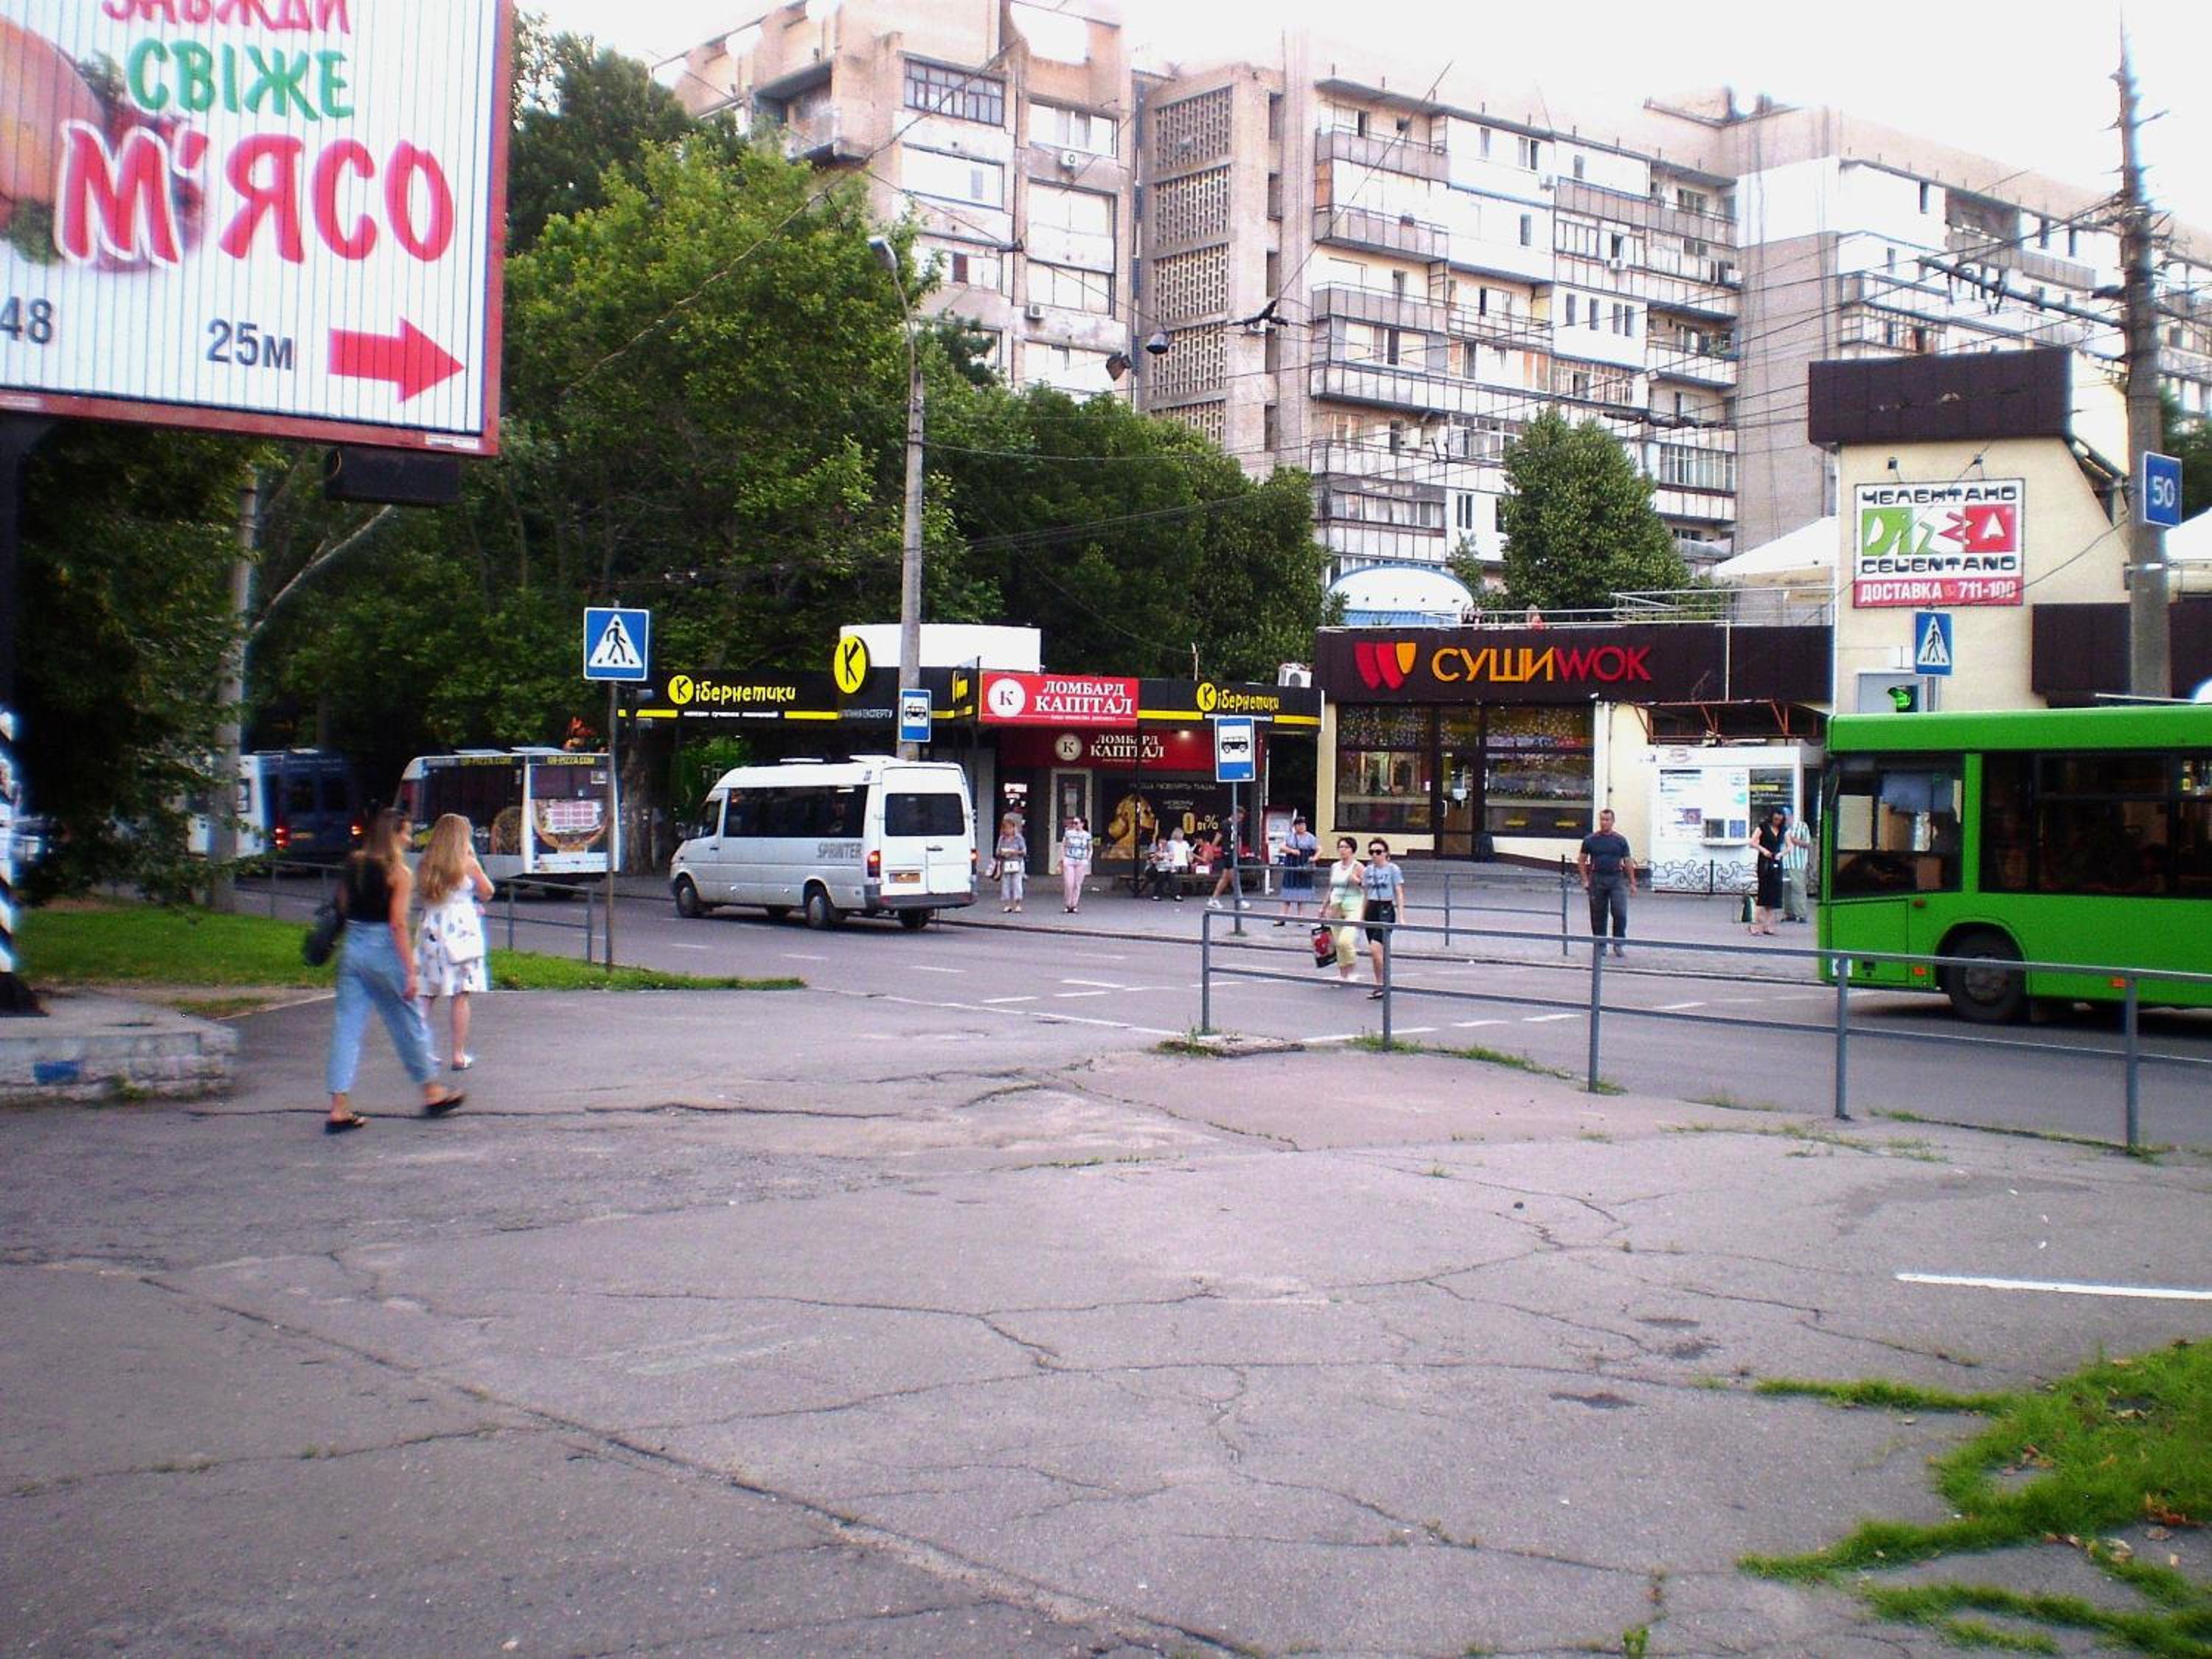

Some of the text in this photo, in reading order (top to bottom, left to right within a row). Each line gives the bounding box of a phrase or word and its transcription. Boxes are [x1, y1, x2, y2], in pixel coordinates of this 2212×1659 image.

[127, 38, 355, 121] СВІЖЕ
[63, 131, 454, 264] М'ЯСО
[0, 296, 52, 344] 48
[1862, 486, 2017, 505] ЧЕЛЕНТАНО
[2152, 476, 2174, 508] 50
[1861, 581, 1943, 602] ДОСТАВКА
[1043, 681, 1125, 697] ЛОМБАРД
[1096, 734, 1158, 745] ЛОМБРД
[817, 841, 862, 859] SPRINTER
